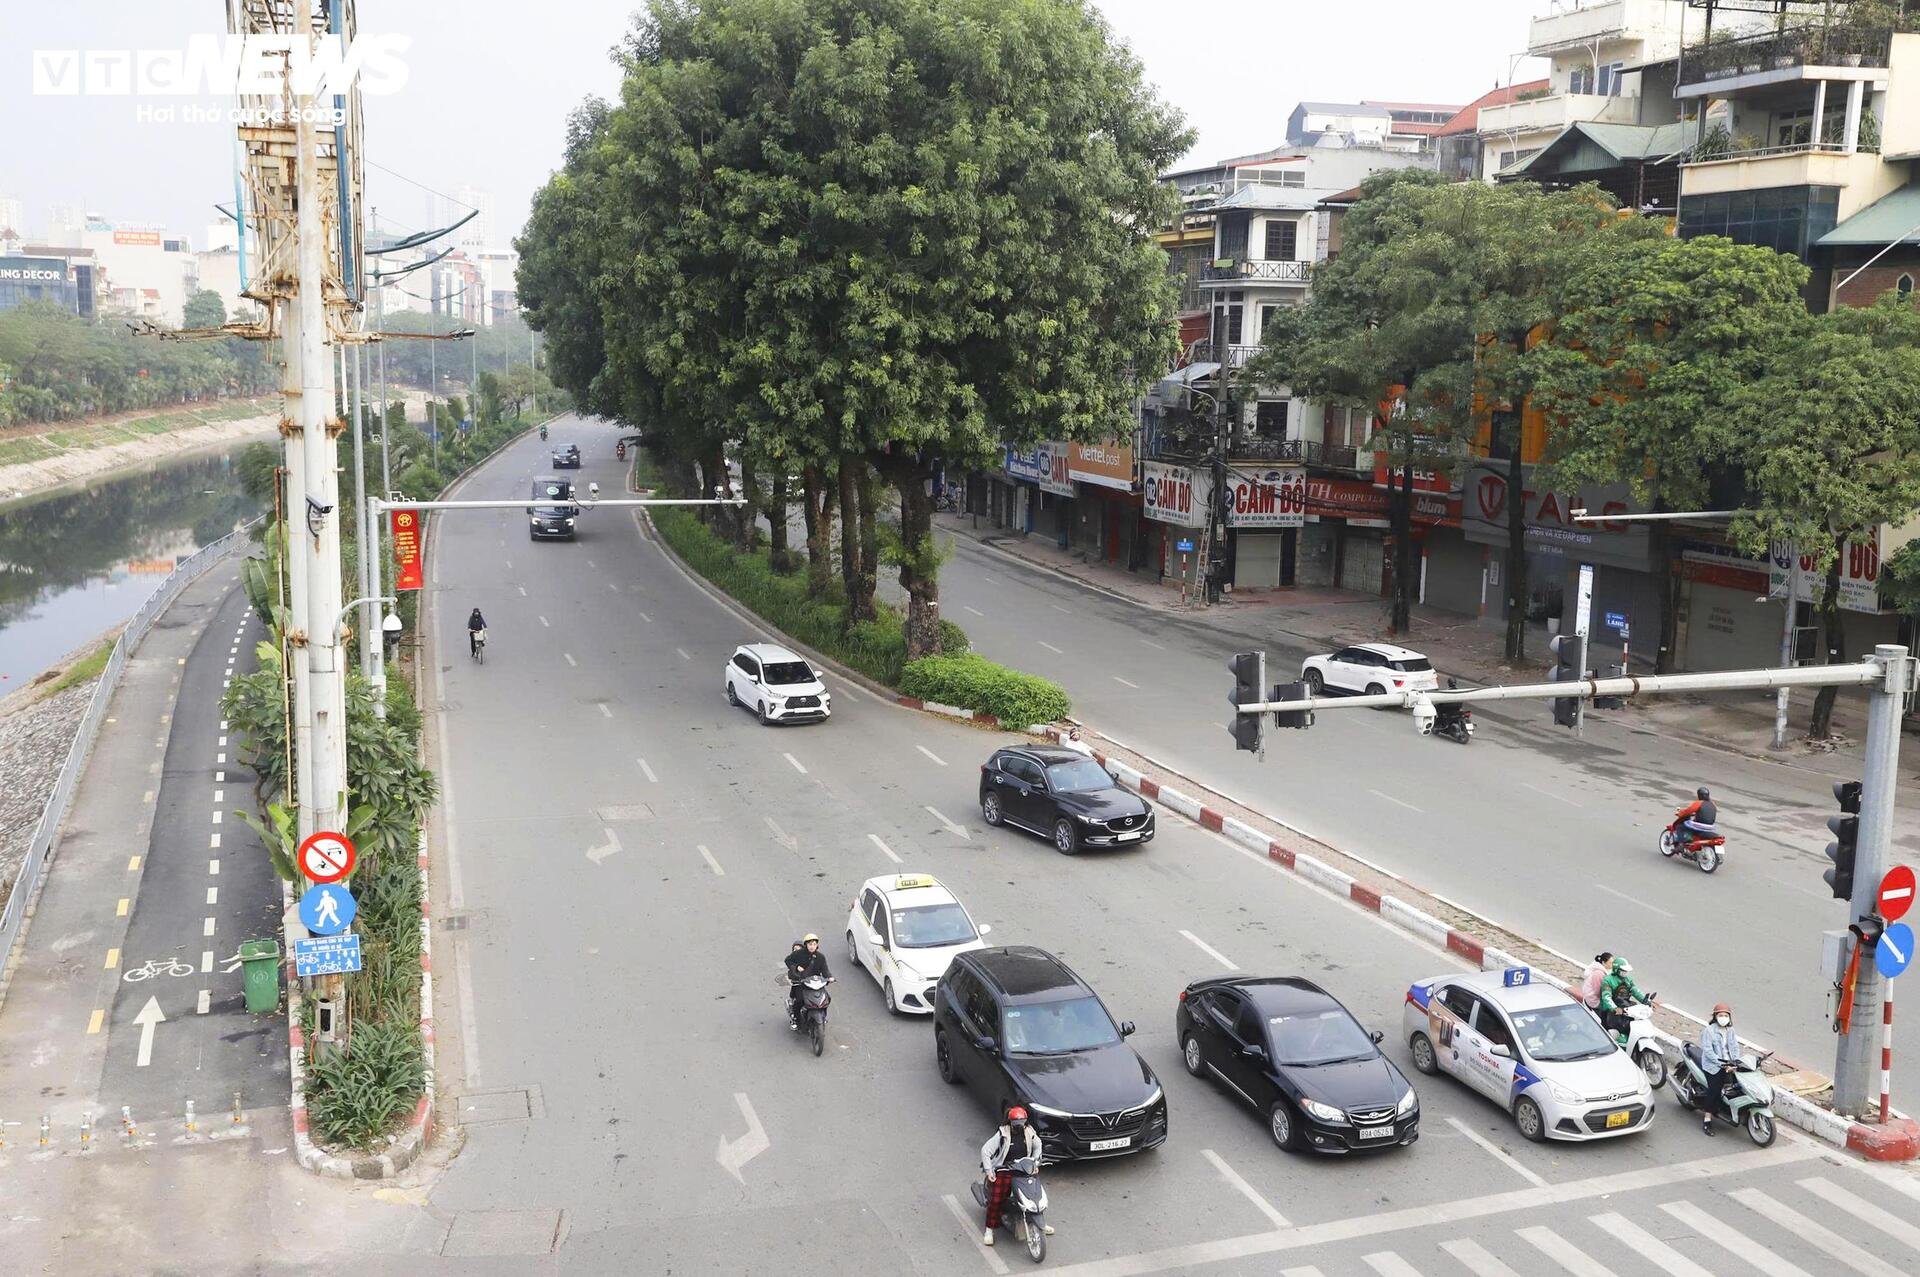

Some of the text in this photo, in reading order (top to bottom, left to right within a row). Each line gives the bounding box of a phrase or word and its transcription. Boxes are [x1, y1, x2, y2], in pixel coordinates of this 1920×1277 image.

[0, 269, 61, 281] ING DECOR
[1078, 446, 1121, 467] viettel post
[1235, 473, 1275, 514] CẦM
[1280, 474, 1304, 514] ĐỒ
[1306, 482, 1332, 499] TH
[1416, 497, 1447, 515] blum
[1478, 1051, 1500, 1070] TOSHIBA
